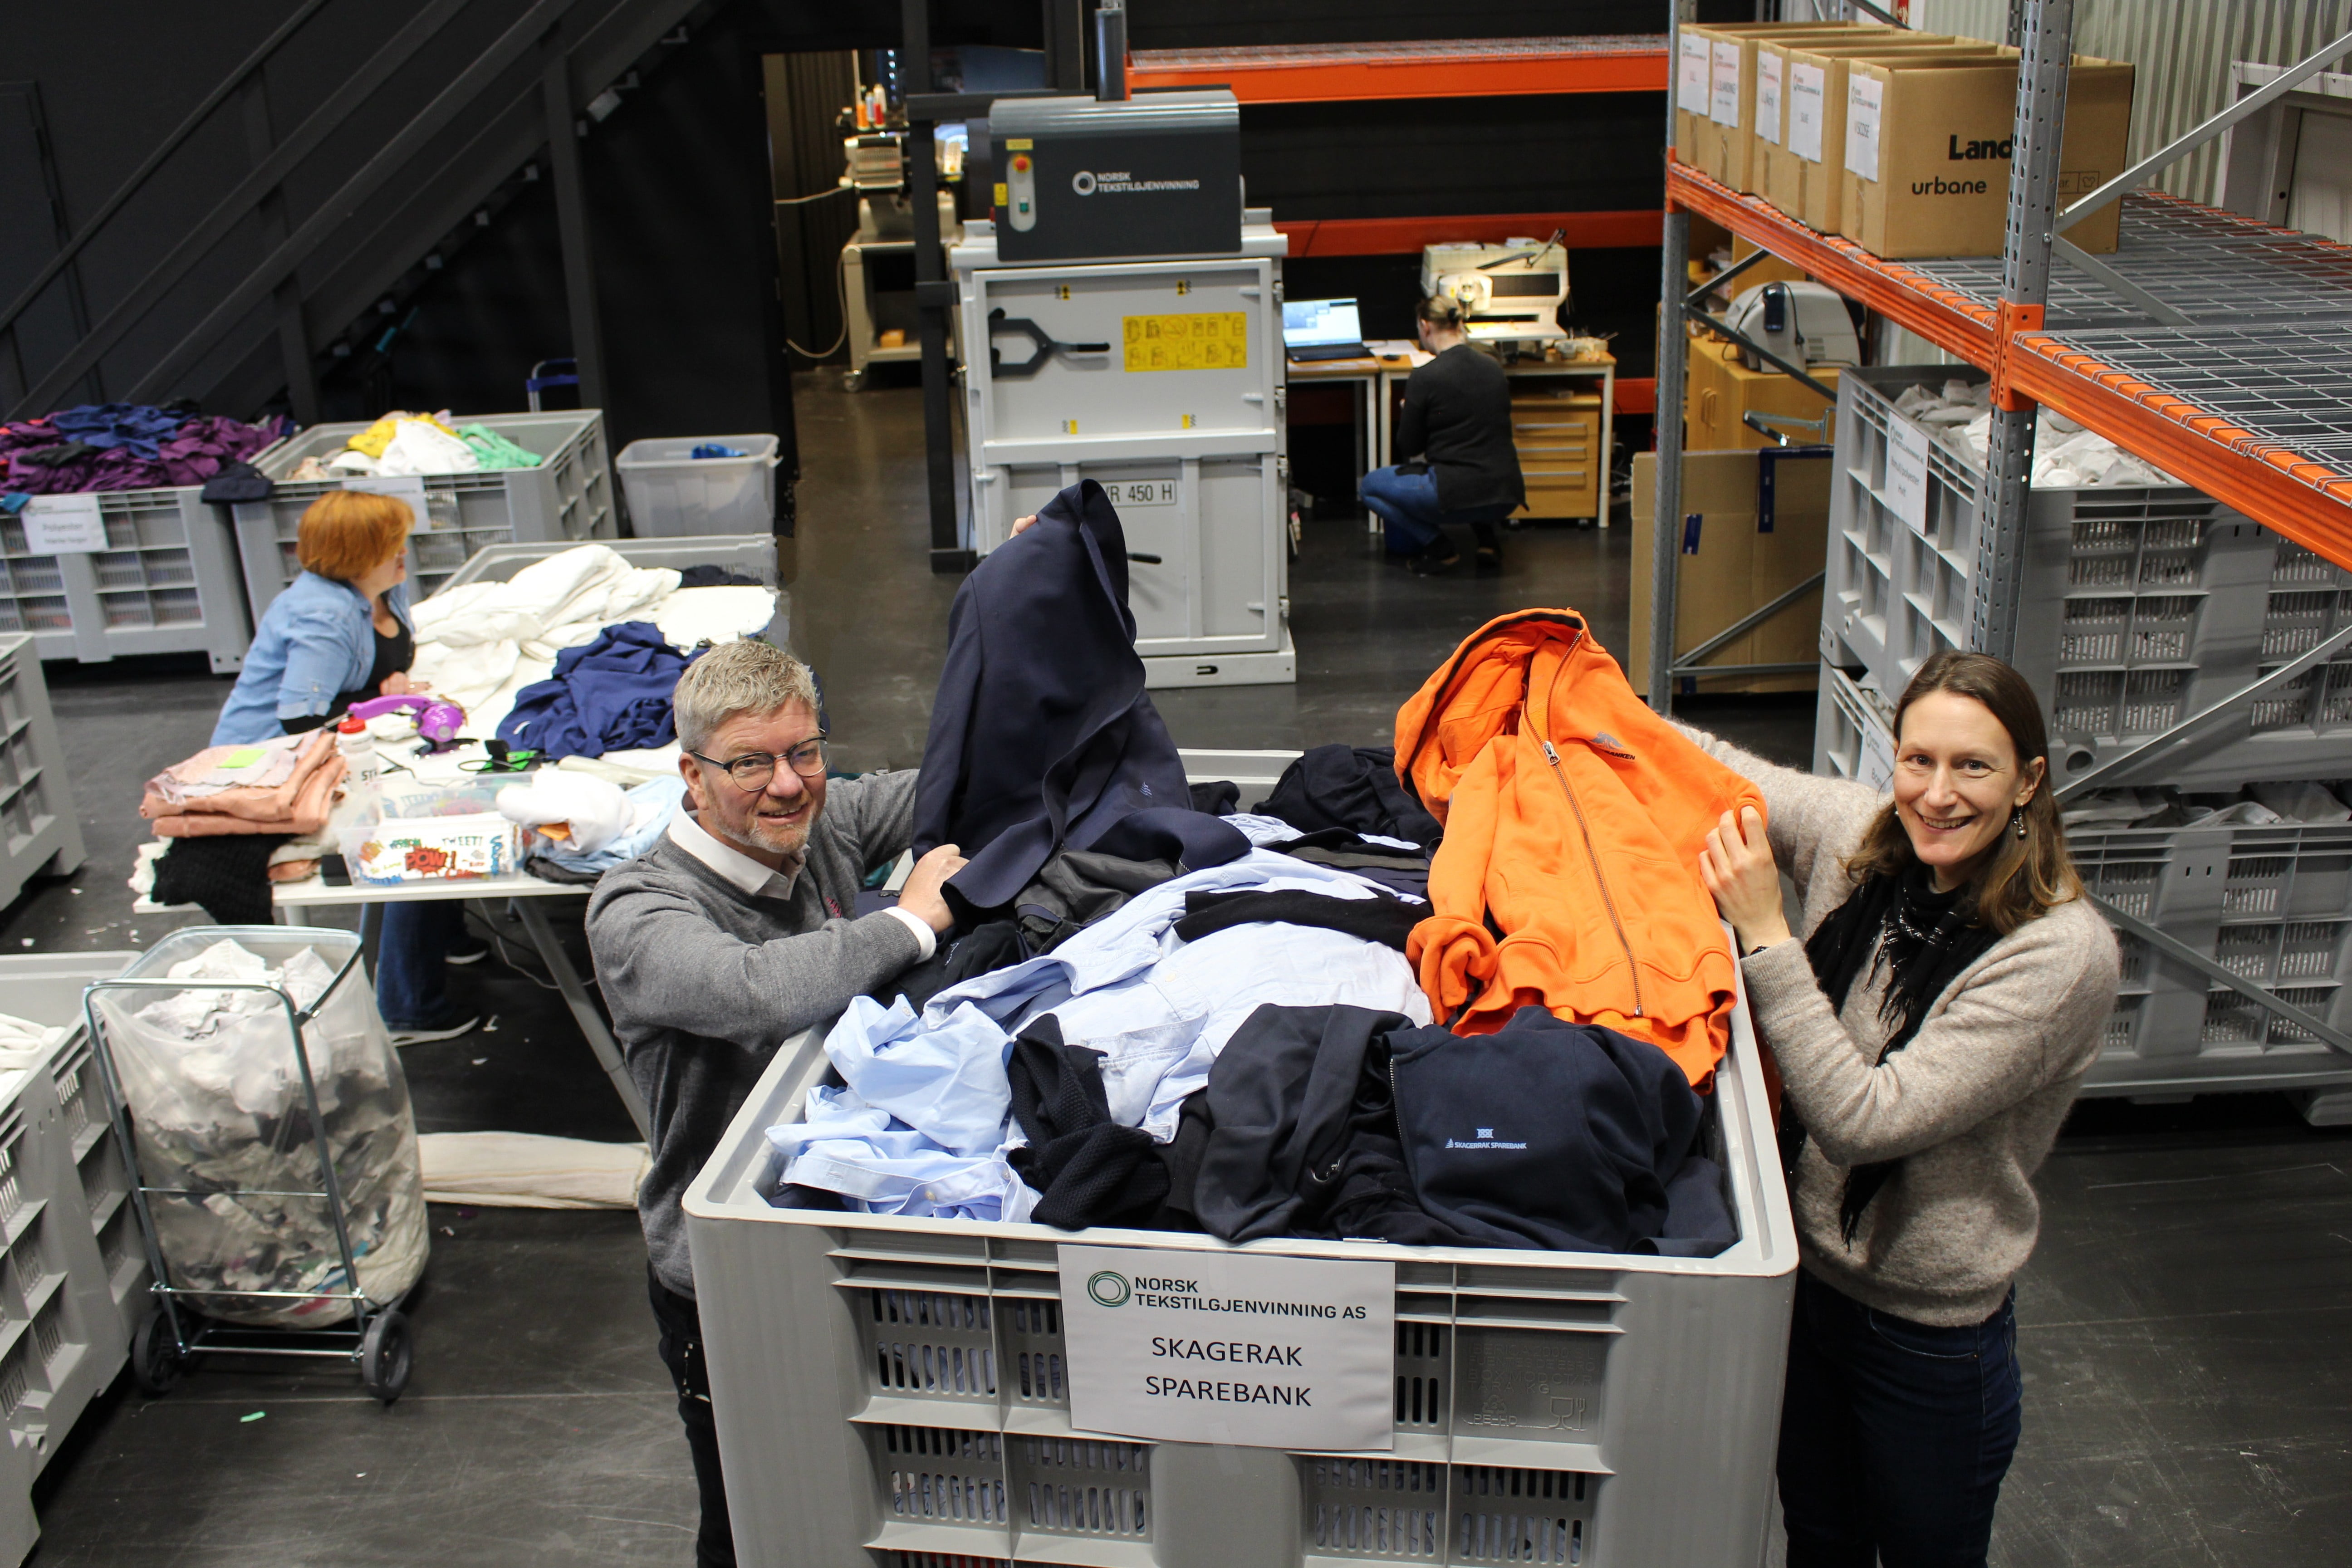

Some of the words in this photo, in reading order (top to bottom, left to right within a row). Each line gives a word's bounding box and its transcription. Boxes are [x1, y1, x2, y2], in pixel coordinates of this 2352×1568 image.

[1097, 172, 1131, 182] NORSK
[1098, 180, 1200, 193] TEKSTILGJENVINNING
[1911, 176, 1987, 195] urbane
[1128, 484, 1154, 502] 450
[1162, 483, 1172, 500] H
[1135, 1276, 1199, 1293] NORSK
[1135, 1293, 1337, 1318] TEKSTILGJENVINNING
[1342, 1306, 1367, 1319] AS
[1152, 1337, 1303, 1367] SKAGERAK
[1534, 1346, 1568, 1358] 2000
[1469, 1355, 1533, 1368] FUENTES
[1536, 1358, 1555, 1369] DE
[1468, 1369, 1505, 1381] BOX
[1509, 1371, 1548, 1384] MOD
[1146, 1376, 1312, 1406] SPAREBANK
[1468, 1380, 1514, 1393] TARA
[1526, 1383, 1550, 1394] KG
[1474, 1413, 1519, 1426] PE-HD
